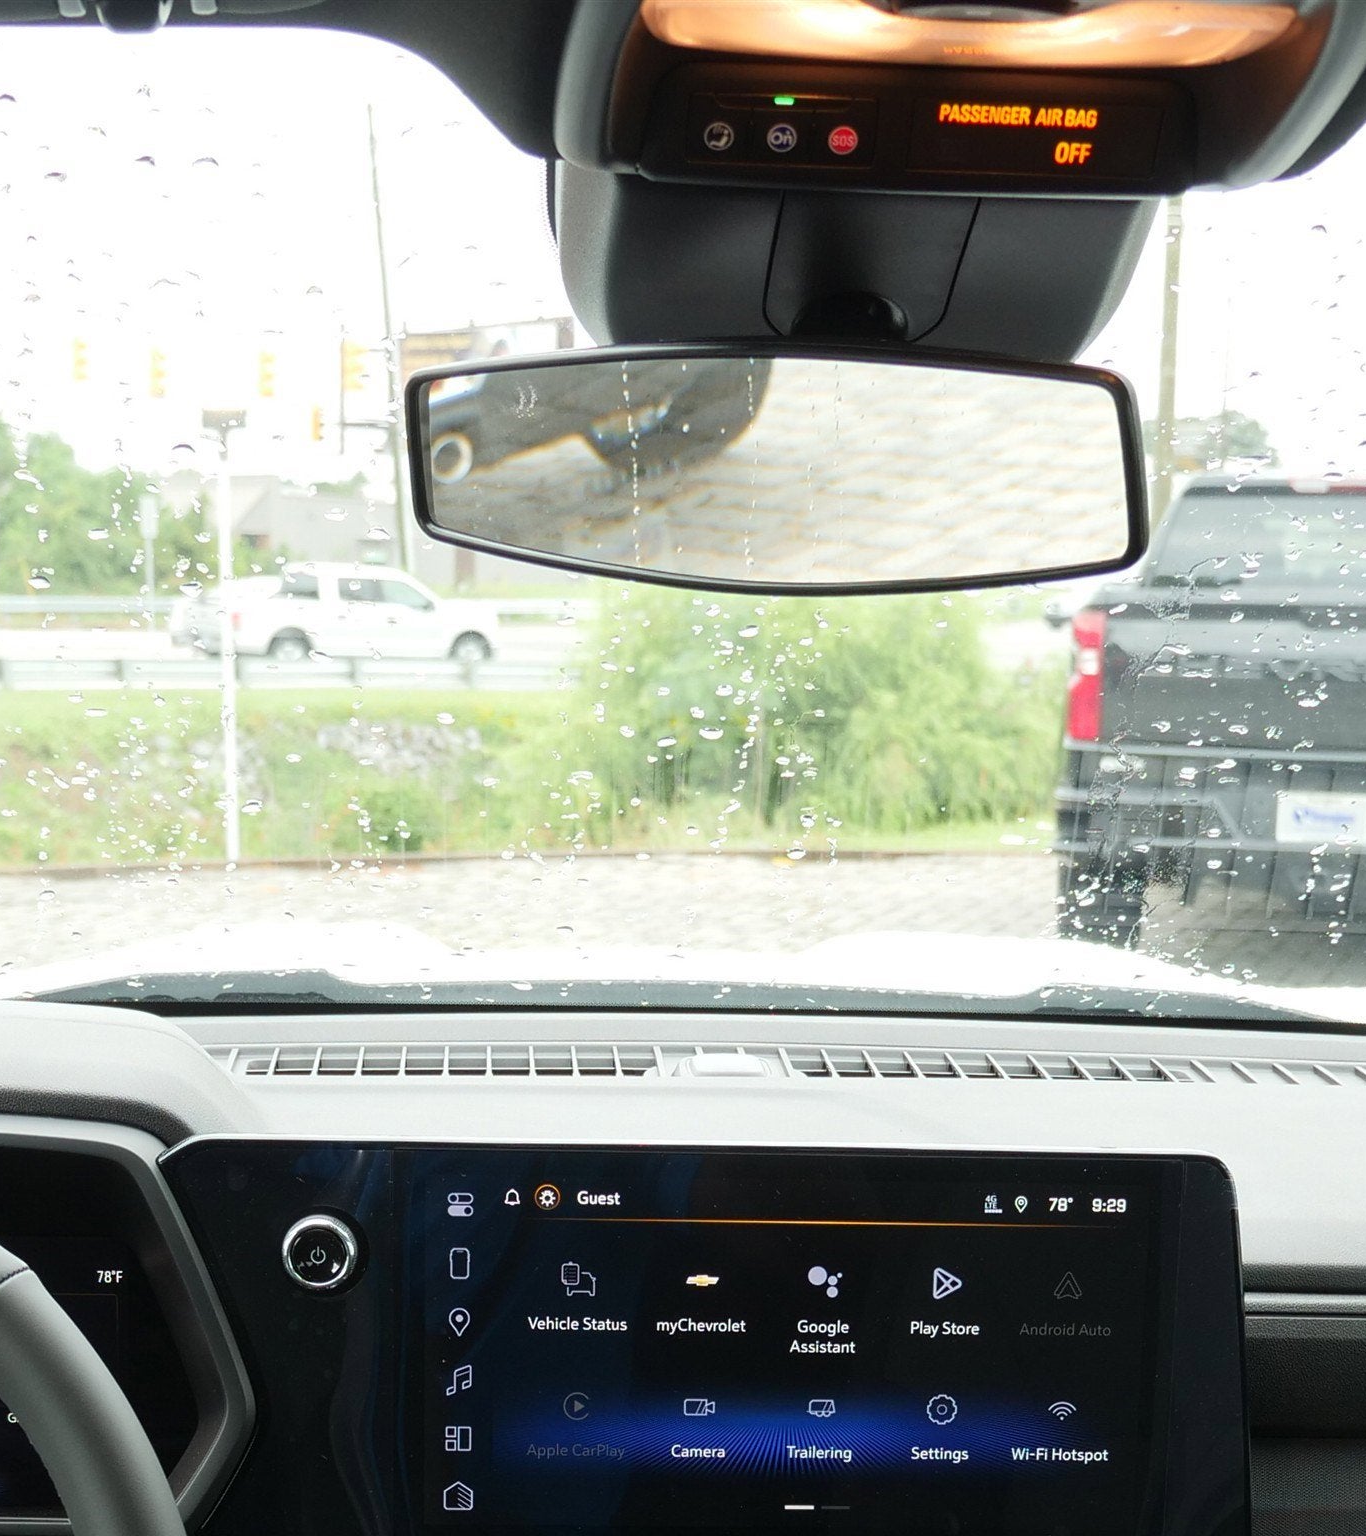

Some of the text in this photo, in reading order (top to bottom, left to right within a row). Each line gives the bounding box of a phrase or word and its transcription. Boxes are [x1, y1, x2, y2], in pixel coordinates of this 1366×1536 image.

[938, 103, 1098, 129] PASSENGER AIR BAG
[831, 134, 855, 147] SOS
[1054, 141, 1092, 164] OFF
[577, 1190, 620, 1205] Guest
[1049, 1197, 1073, 1212] 78°
[1092, 1198, 1126, 1212] 9:29
[528, 1316, 627, 1331] Vehicle Status
[657, 1318, 746, 1334] myChevrolet
[797, 1320, 849, 1337] Google
[910, 1321, 980, 1338] Play Store
[1019, 1323, 1111, 1336] Android Auto
[789, 1340, 856, 1354] Assistant
[526, 1443, 625, 1460] Apple CarPlay
[671, 1444, 726, 1458] Camera
[786, 1445, 852, 1462] Trailering
[911, 1447, 968, 1463] Settings
[1011, 1447, 1109, 1464] Wi-Fi Hotspot
